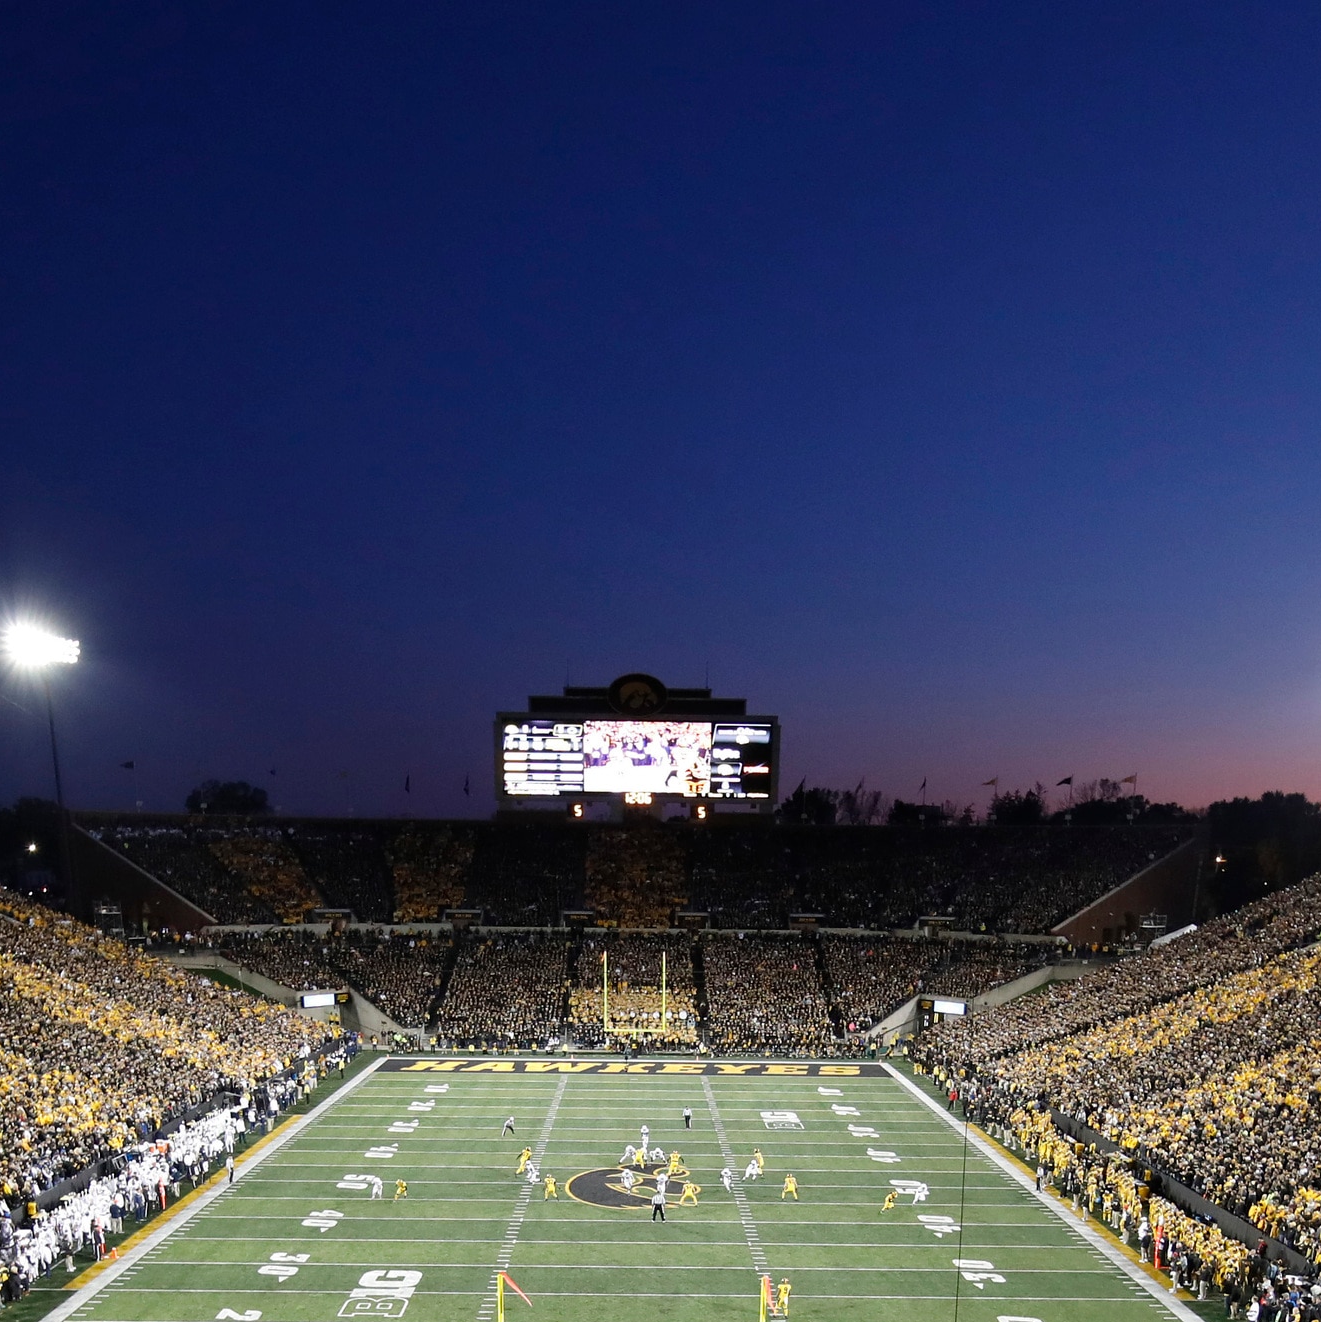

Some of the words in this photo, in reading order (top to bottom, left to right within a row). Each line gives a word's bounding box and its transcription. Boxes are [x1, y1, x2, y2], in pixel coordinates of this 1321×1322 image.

[400, 1060, 862, 1076] HAWKEYES
[336, 1174, 377, 1190] 50
[300, 1209, 345, 1227] 40
[917, 1214, 962, 1233] 40
[257, 1252, 311, 1277] 30
[952, 1258, 1007, 1283] 30
